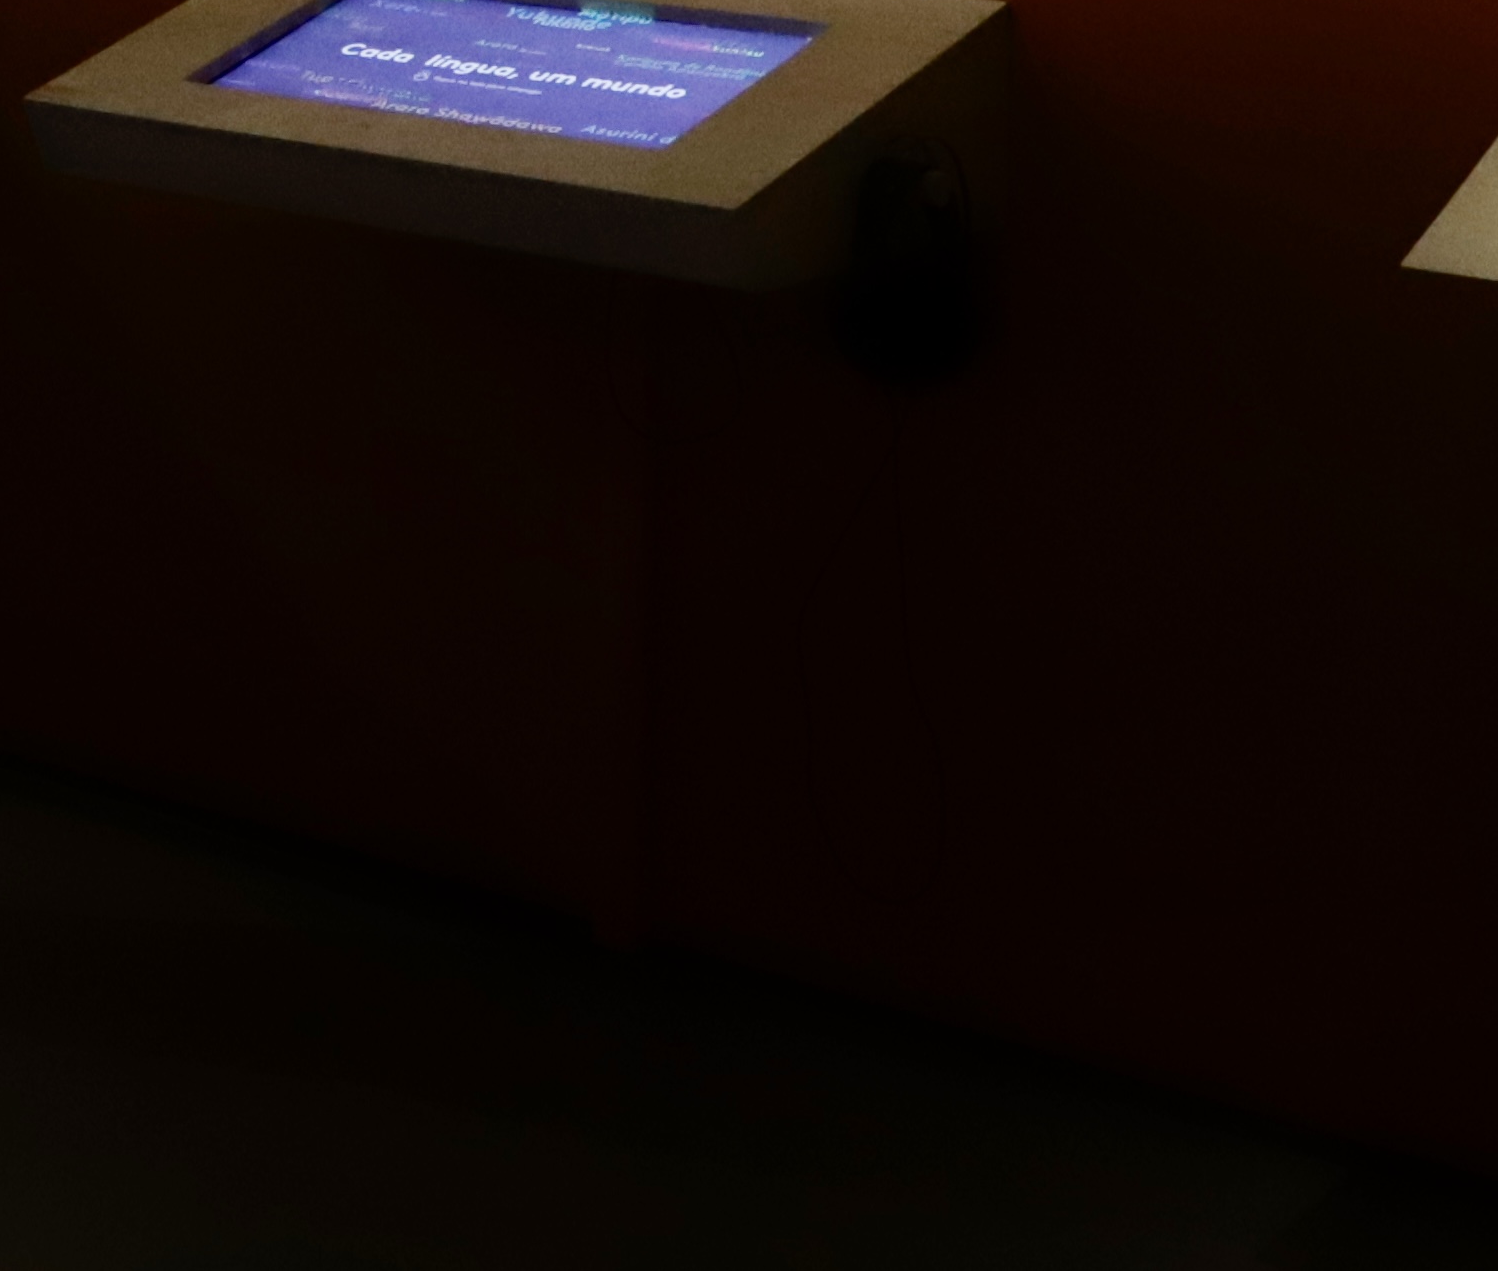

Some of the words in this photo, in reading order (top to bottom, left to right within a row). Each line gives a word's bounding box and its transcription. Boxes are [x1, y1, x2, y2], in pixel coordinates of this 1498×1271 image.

[340, 42, 415, 64] Cada
[424, 51, 519, 80] língua,
[528, 70, 577, 86] um
[581, 75, 687, 100] mundo
